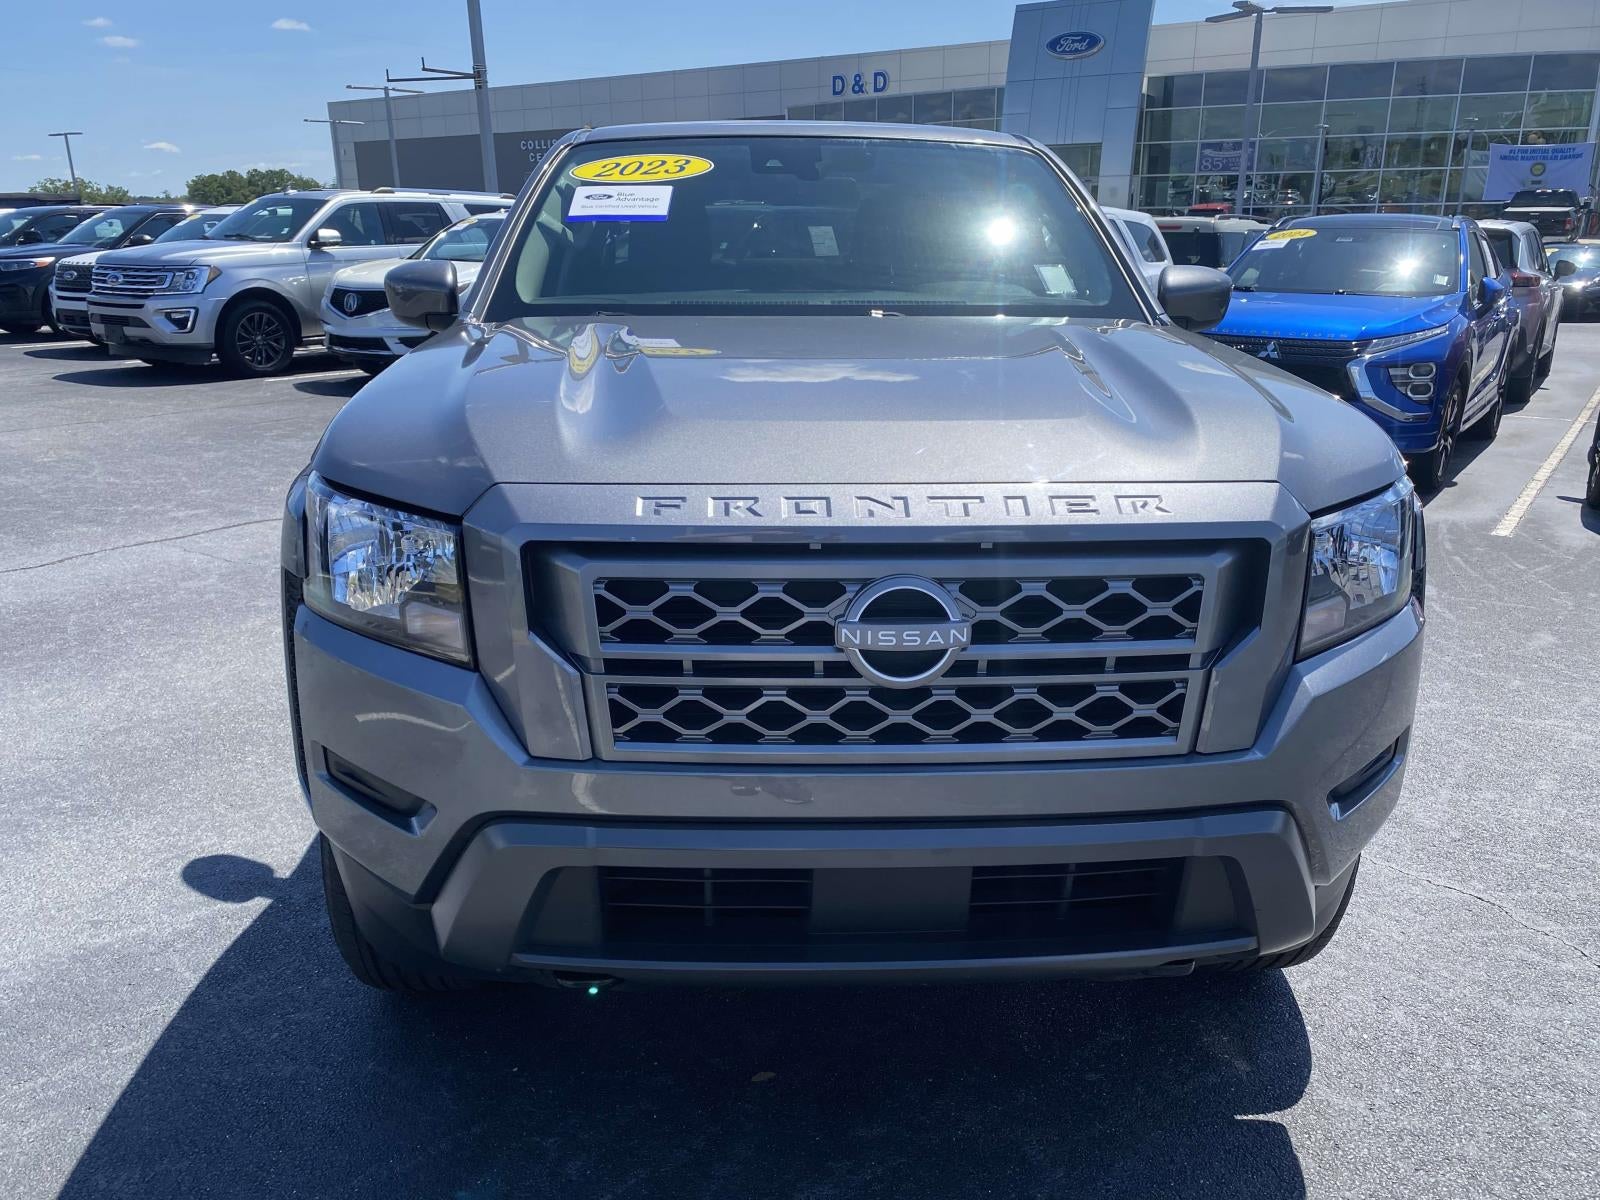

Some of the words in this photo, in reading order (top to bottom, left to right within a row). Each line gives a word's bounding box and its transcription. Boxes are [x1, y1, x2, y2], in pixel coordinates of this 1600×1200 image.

[1056, 36, 1090, 51] Ford
[832, 75, 845, 96] D
[851, 73, 865, 95] &
[873, 71, 888, 93] D
[593, 159, 691, 178] 2023
[635, 494, 1173, 519] FRONTIER
[841, 627, 968, 646] NISSAN
